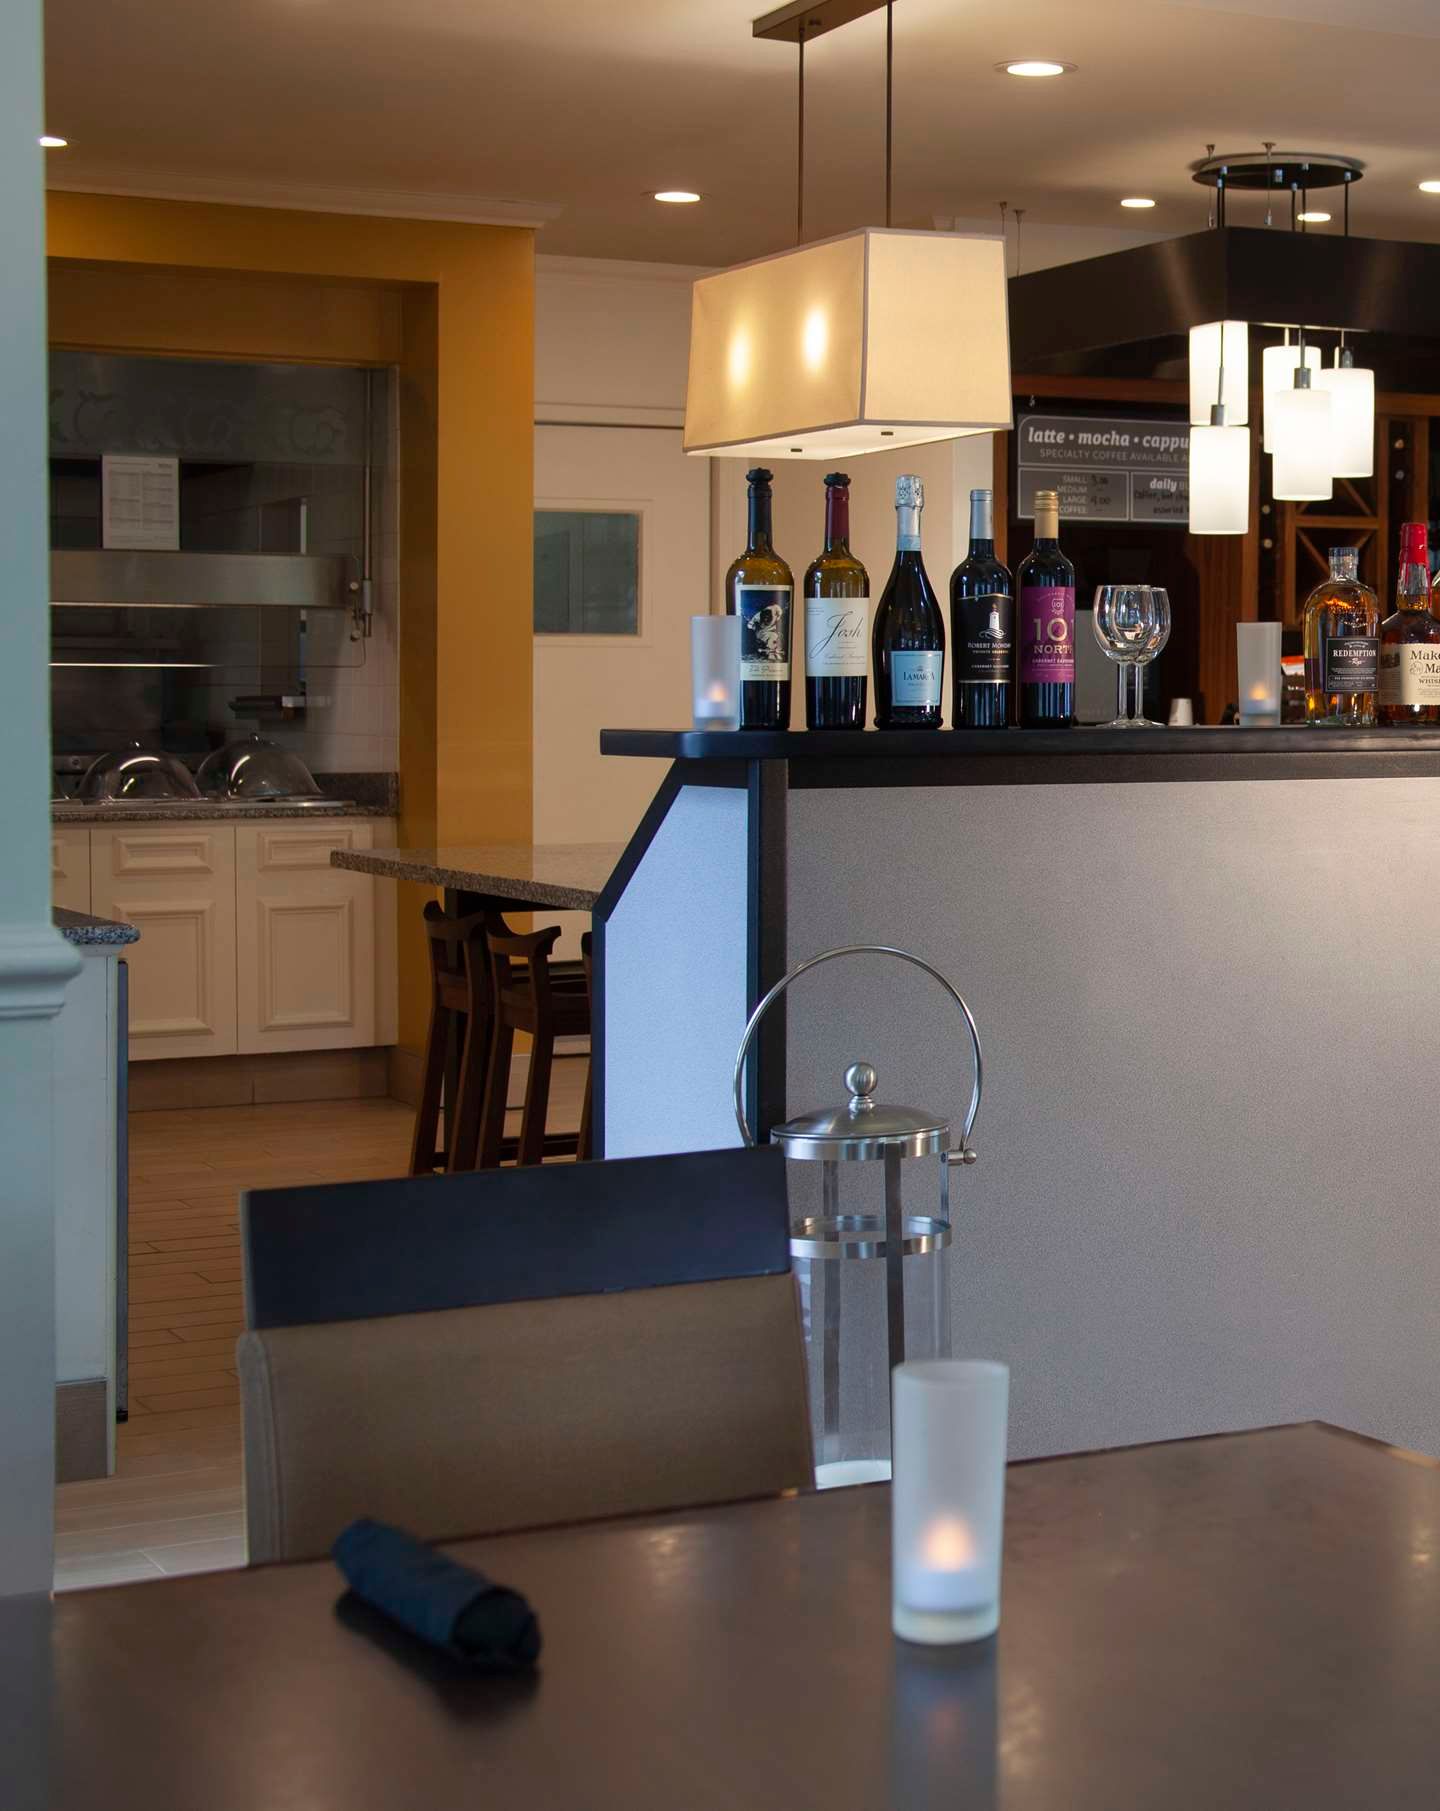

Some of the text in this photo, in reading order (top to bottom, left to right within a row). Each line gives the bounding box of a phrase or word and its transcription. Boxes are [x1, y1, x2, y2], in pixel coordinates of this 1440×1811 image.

[1028, 427, 1066, 444] latte
[1078, 430, 1130, 447] mocha
[1092, 450, 1128, 461] COFFEE
[1150, 477, 1178, 492] daily
[1333, 649, 1376, 657] REDEMPTION
